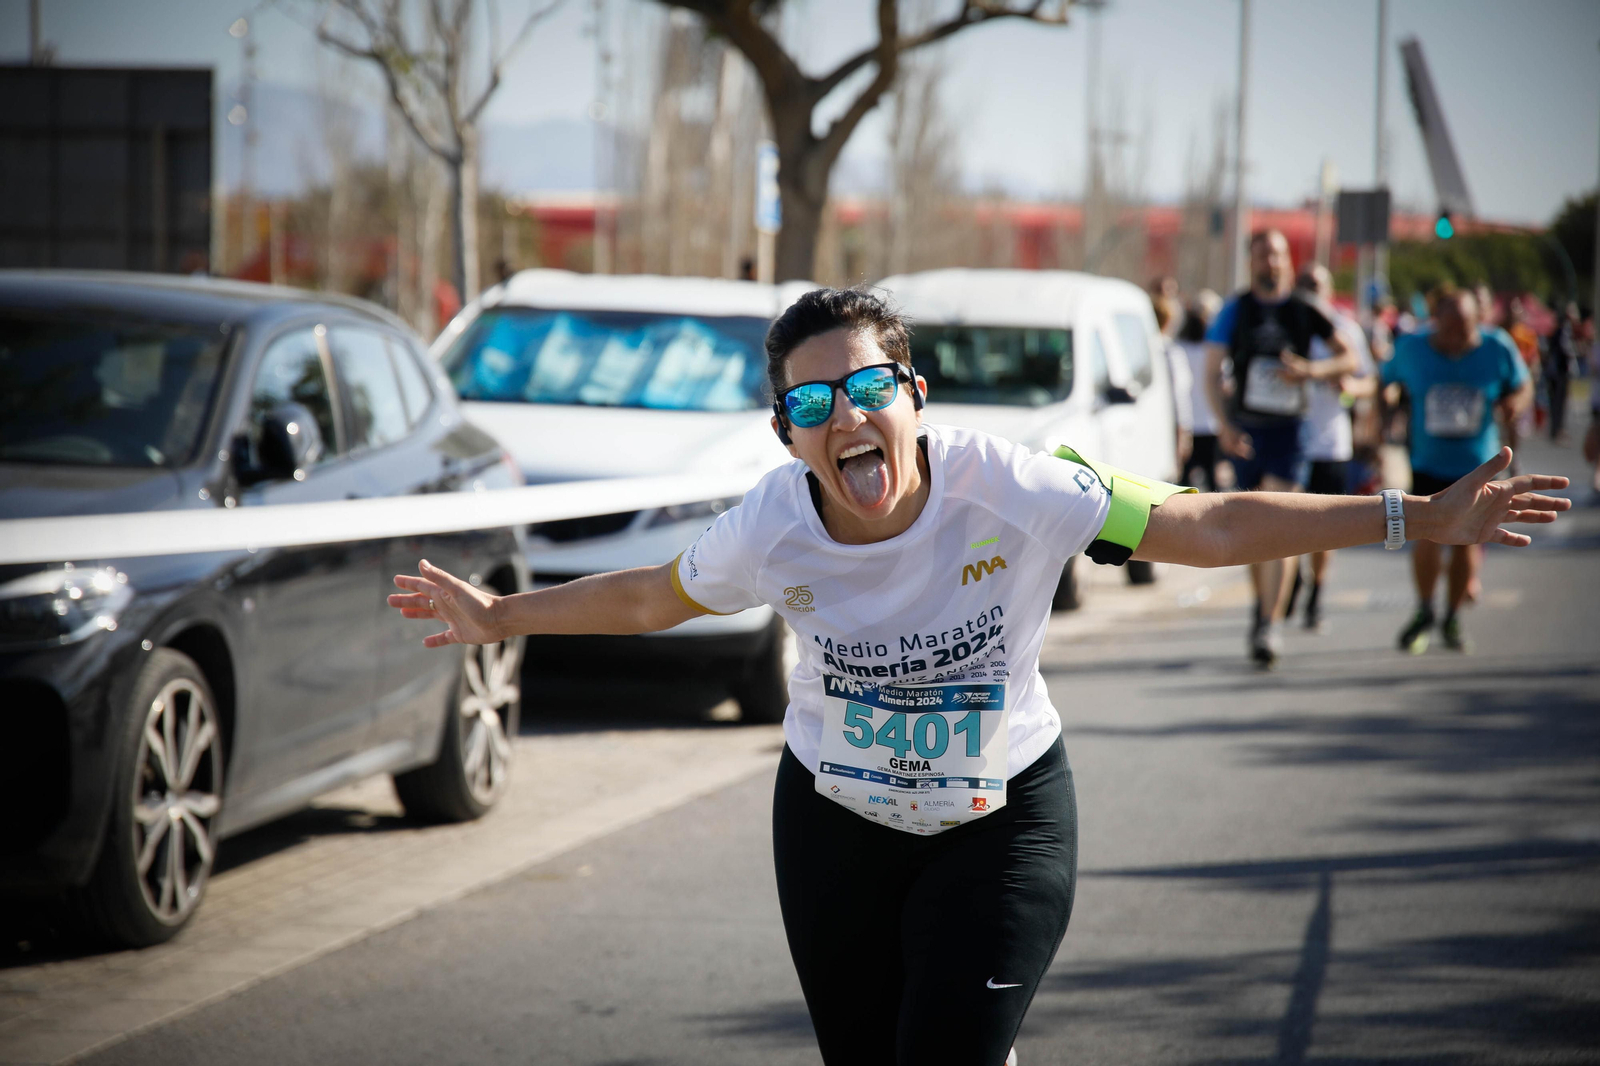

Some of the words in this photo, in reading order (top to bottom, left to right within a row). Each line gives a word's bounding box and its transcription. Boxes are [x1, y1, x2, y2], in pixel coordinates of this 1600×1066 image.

[783, 585, 814, 606] 25
[814, 635, 888, 658] Medio
[899, 604, 1004, 653] Maratón
[823, 652, 927, 678] Almería
[932, 624, 1004, 668] 2024
[989, 660, 1006, 668] 2006
[970, 671, 987, 679] 2014
[878, 686, 904, 697] Medio
[906, 688, 943, 698] Maratón
[878, 693, 915, 706] Almería
[916, 696, 943, 706] 2024
[842, 701, 981, 759] 5401
[889, 757, 931, 772] GEMA
[877, 765, 892, 773] GEMA
[891, 768, 917, 778] MARTINEZ
[868, 795, 898, 806] NEXAL
